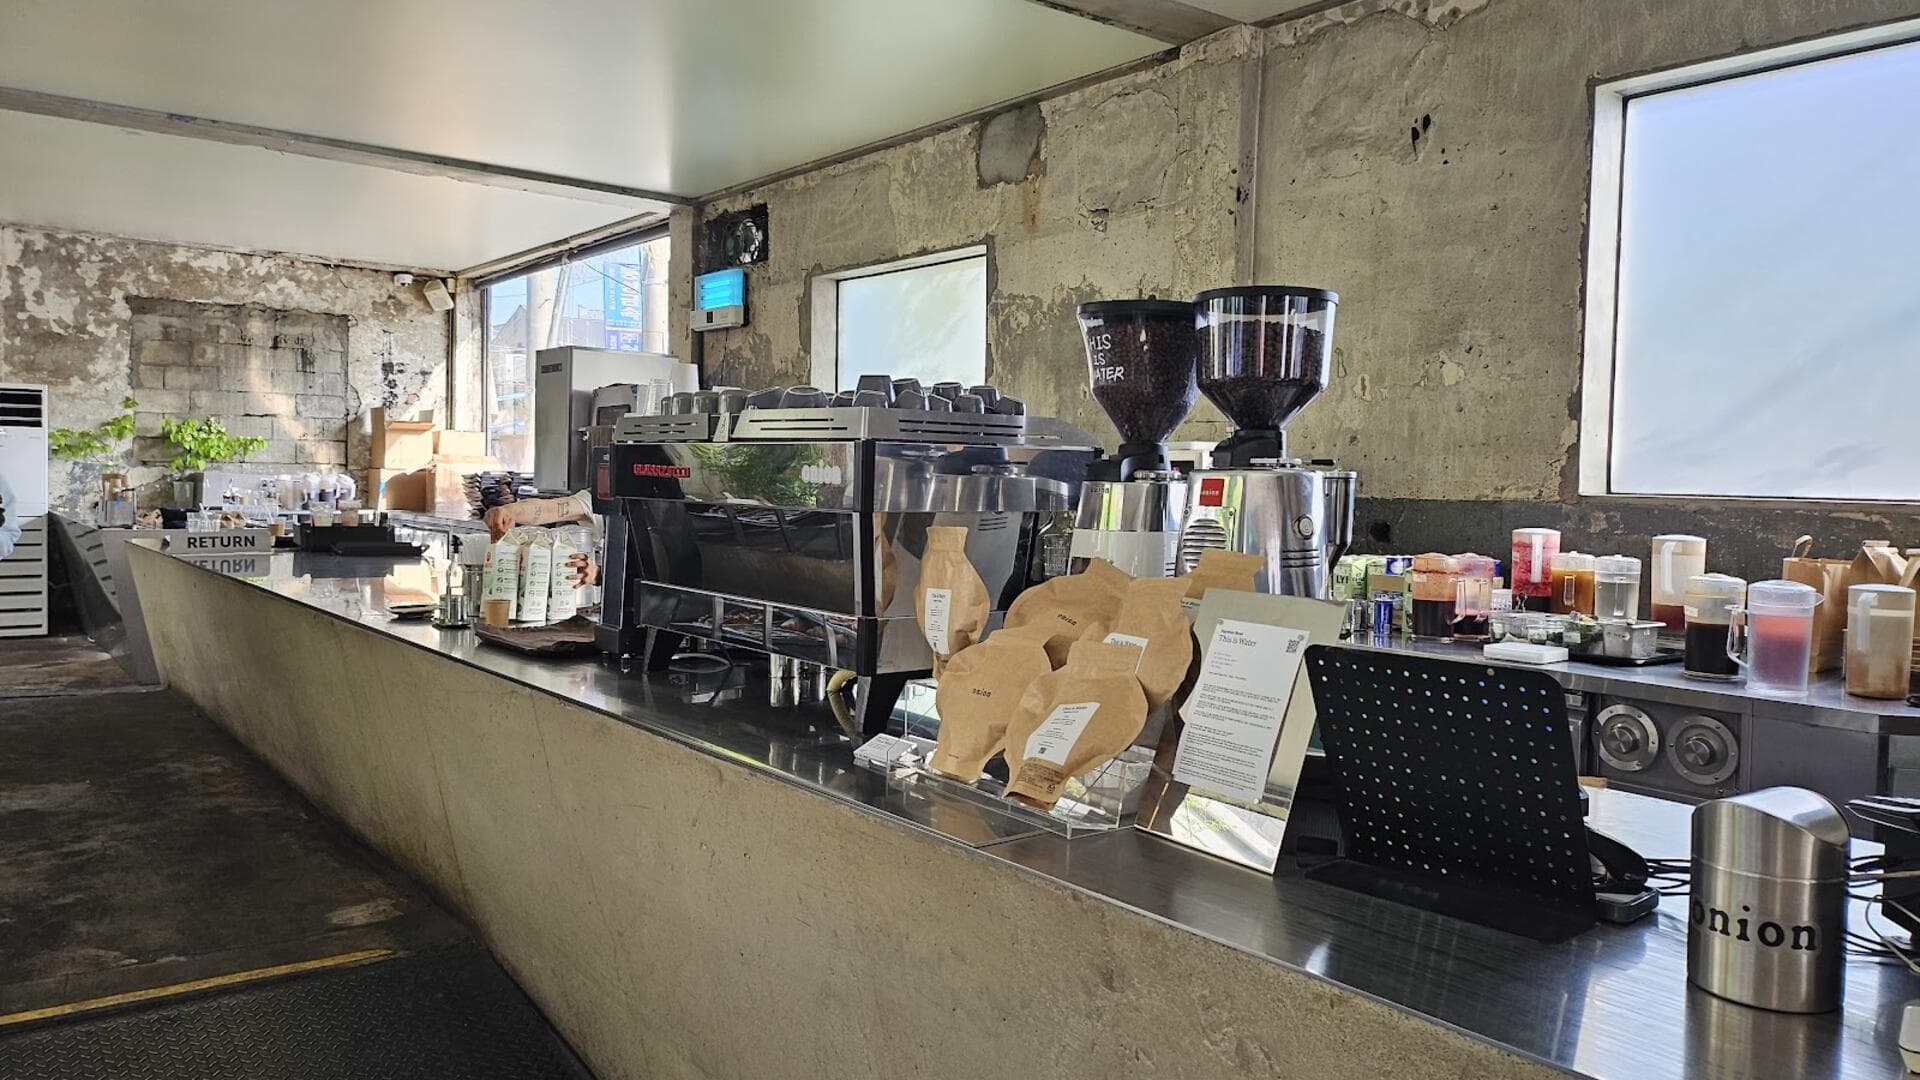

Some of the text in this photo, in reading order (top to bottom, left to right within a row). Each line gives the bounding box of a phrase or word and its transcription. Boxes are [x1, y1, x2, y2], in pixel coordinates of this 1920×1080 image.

[1086, 333, 1112, 351] HIS
[1095, 366, 1125, 382] ATER
[186, 535, 256, 549] RETURN
[1692, 897, 1817, 951] onion
